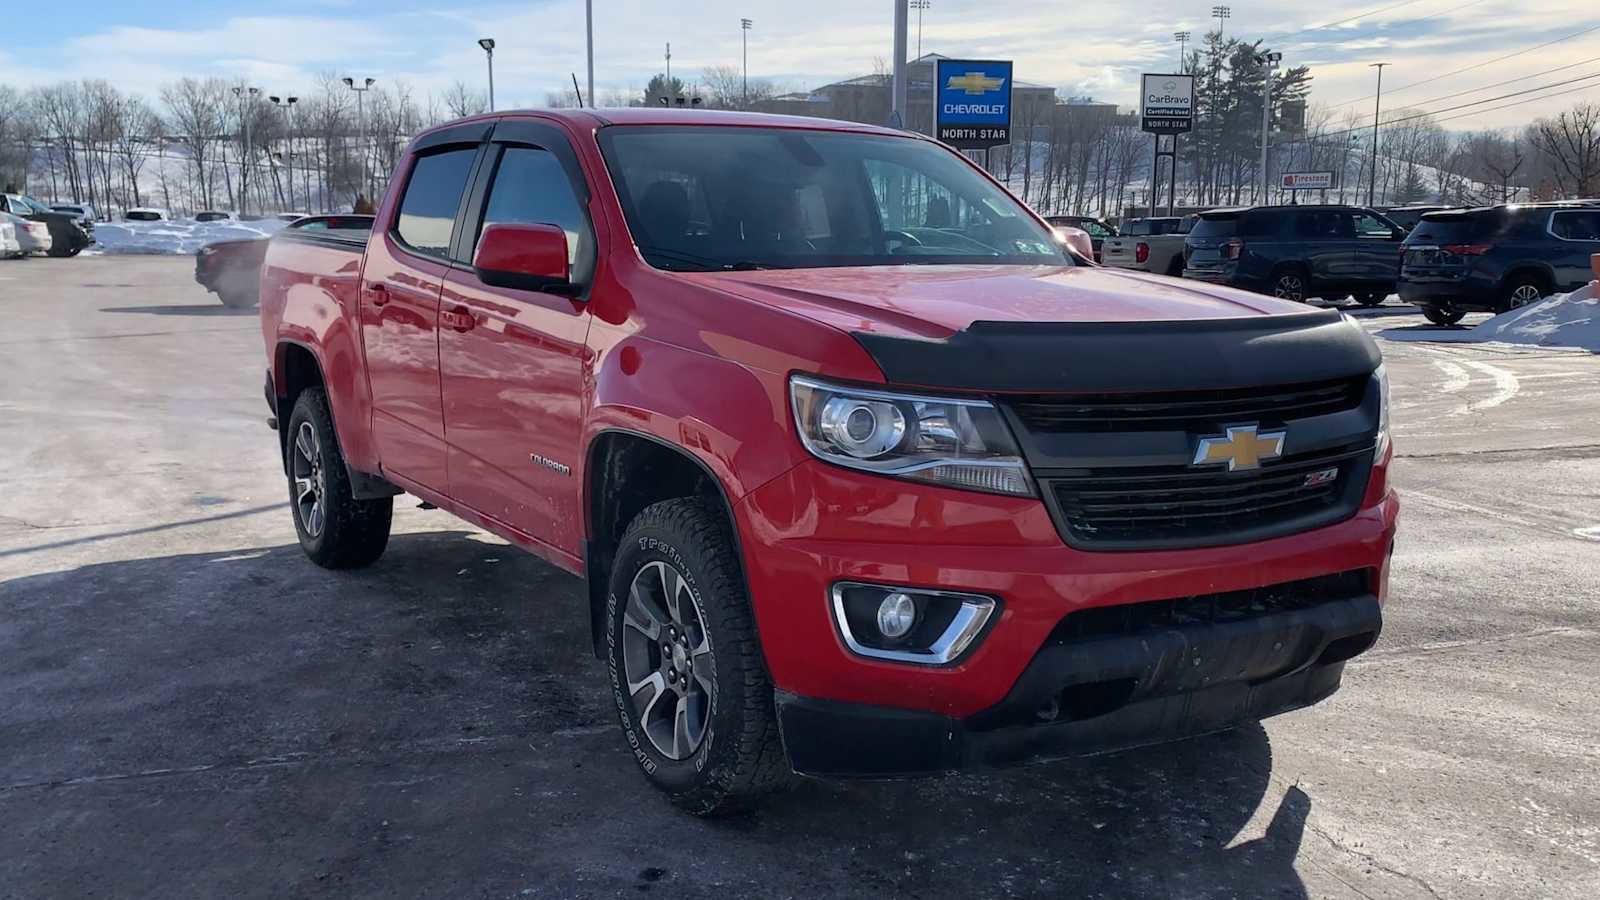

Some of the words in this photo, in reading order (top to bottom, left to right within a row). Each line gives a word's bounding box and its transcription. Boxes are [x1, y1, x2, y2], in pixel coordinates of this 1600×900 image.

[1149, 95, 1189, 103] CarBravo
[944, 104, 1005, 114] CHEVROLET
[942, 129, 976, 139] NORTH
[979, 129, 1006, 139] STAR
[529, 453, 570, 475] COLORADO
